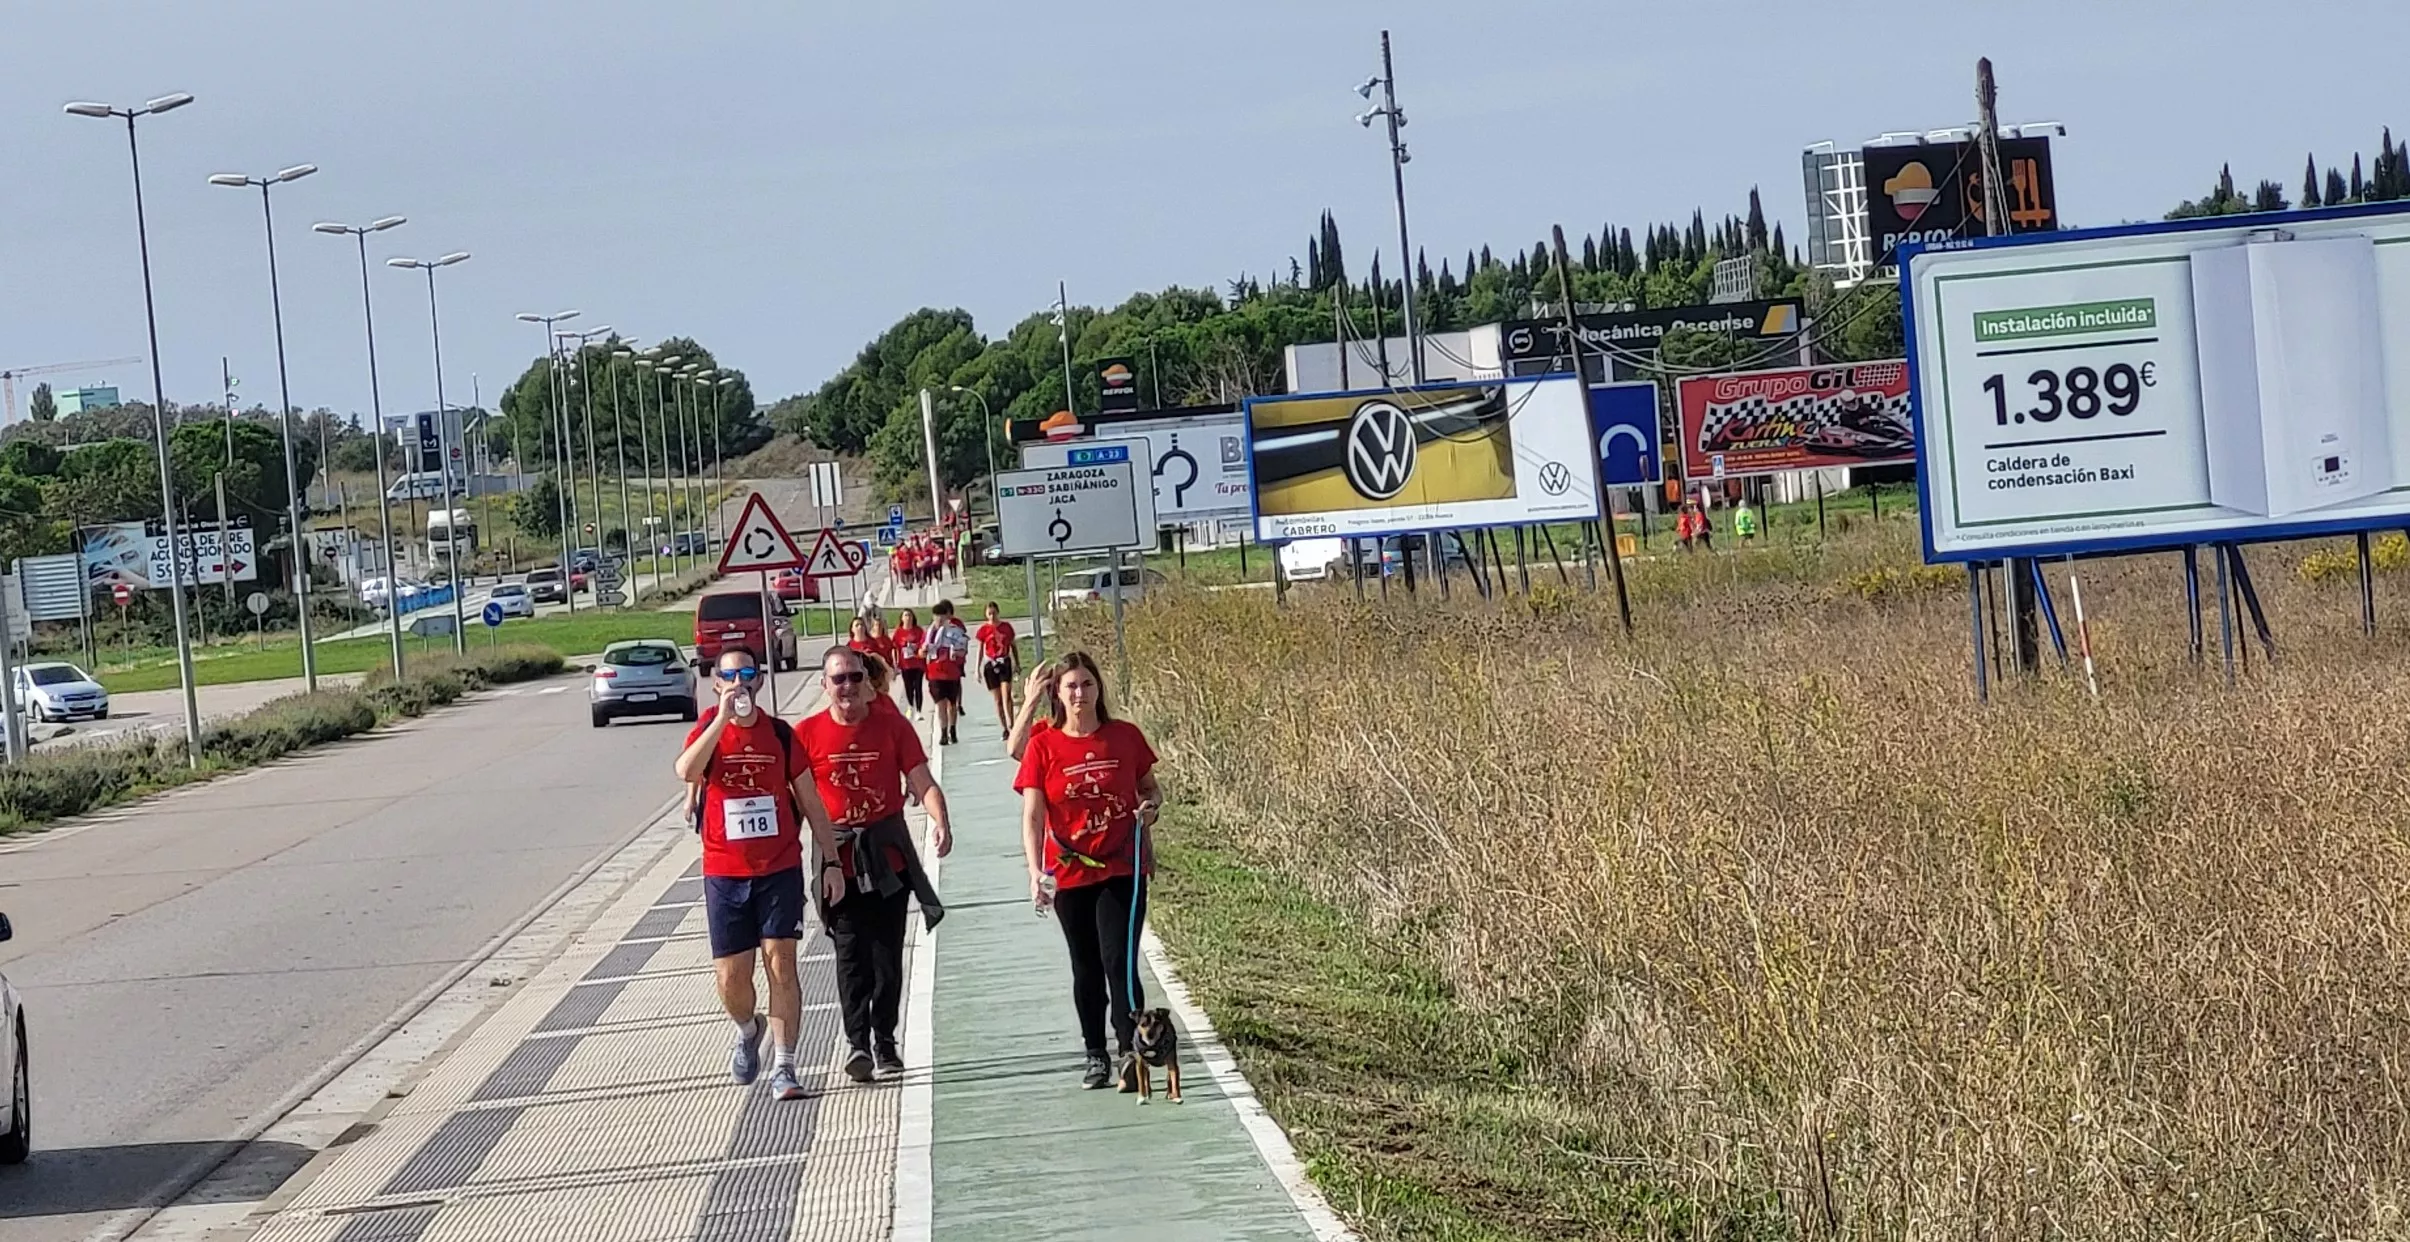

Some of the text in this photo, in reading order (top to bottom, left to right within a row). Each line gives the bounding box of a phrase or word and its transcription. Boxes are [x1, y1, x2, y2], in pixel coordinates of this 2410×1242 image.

[1983, 312, 2077, 335] Instalación
[1983, 361, 2157, 425] 1.389€
[1987, 453, 2070, 472] Caldera de
[1047, 468, 1106, 482] ZARAGOZA
[1988, 464, 2134, 490] condensación Baxi
[1049, 494, 1077, 505] JACA
[200, 534, 215, 546] DE
[738, 816, 768, 834] 118
